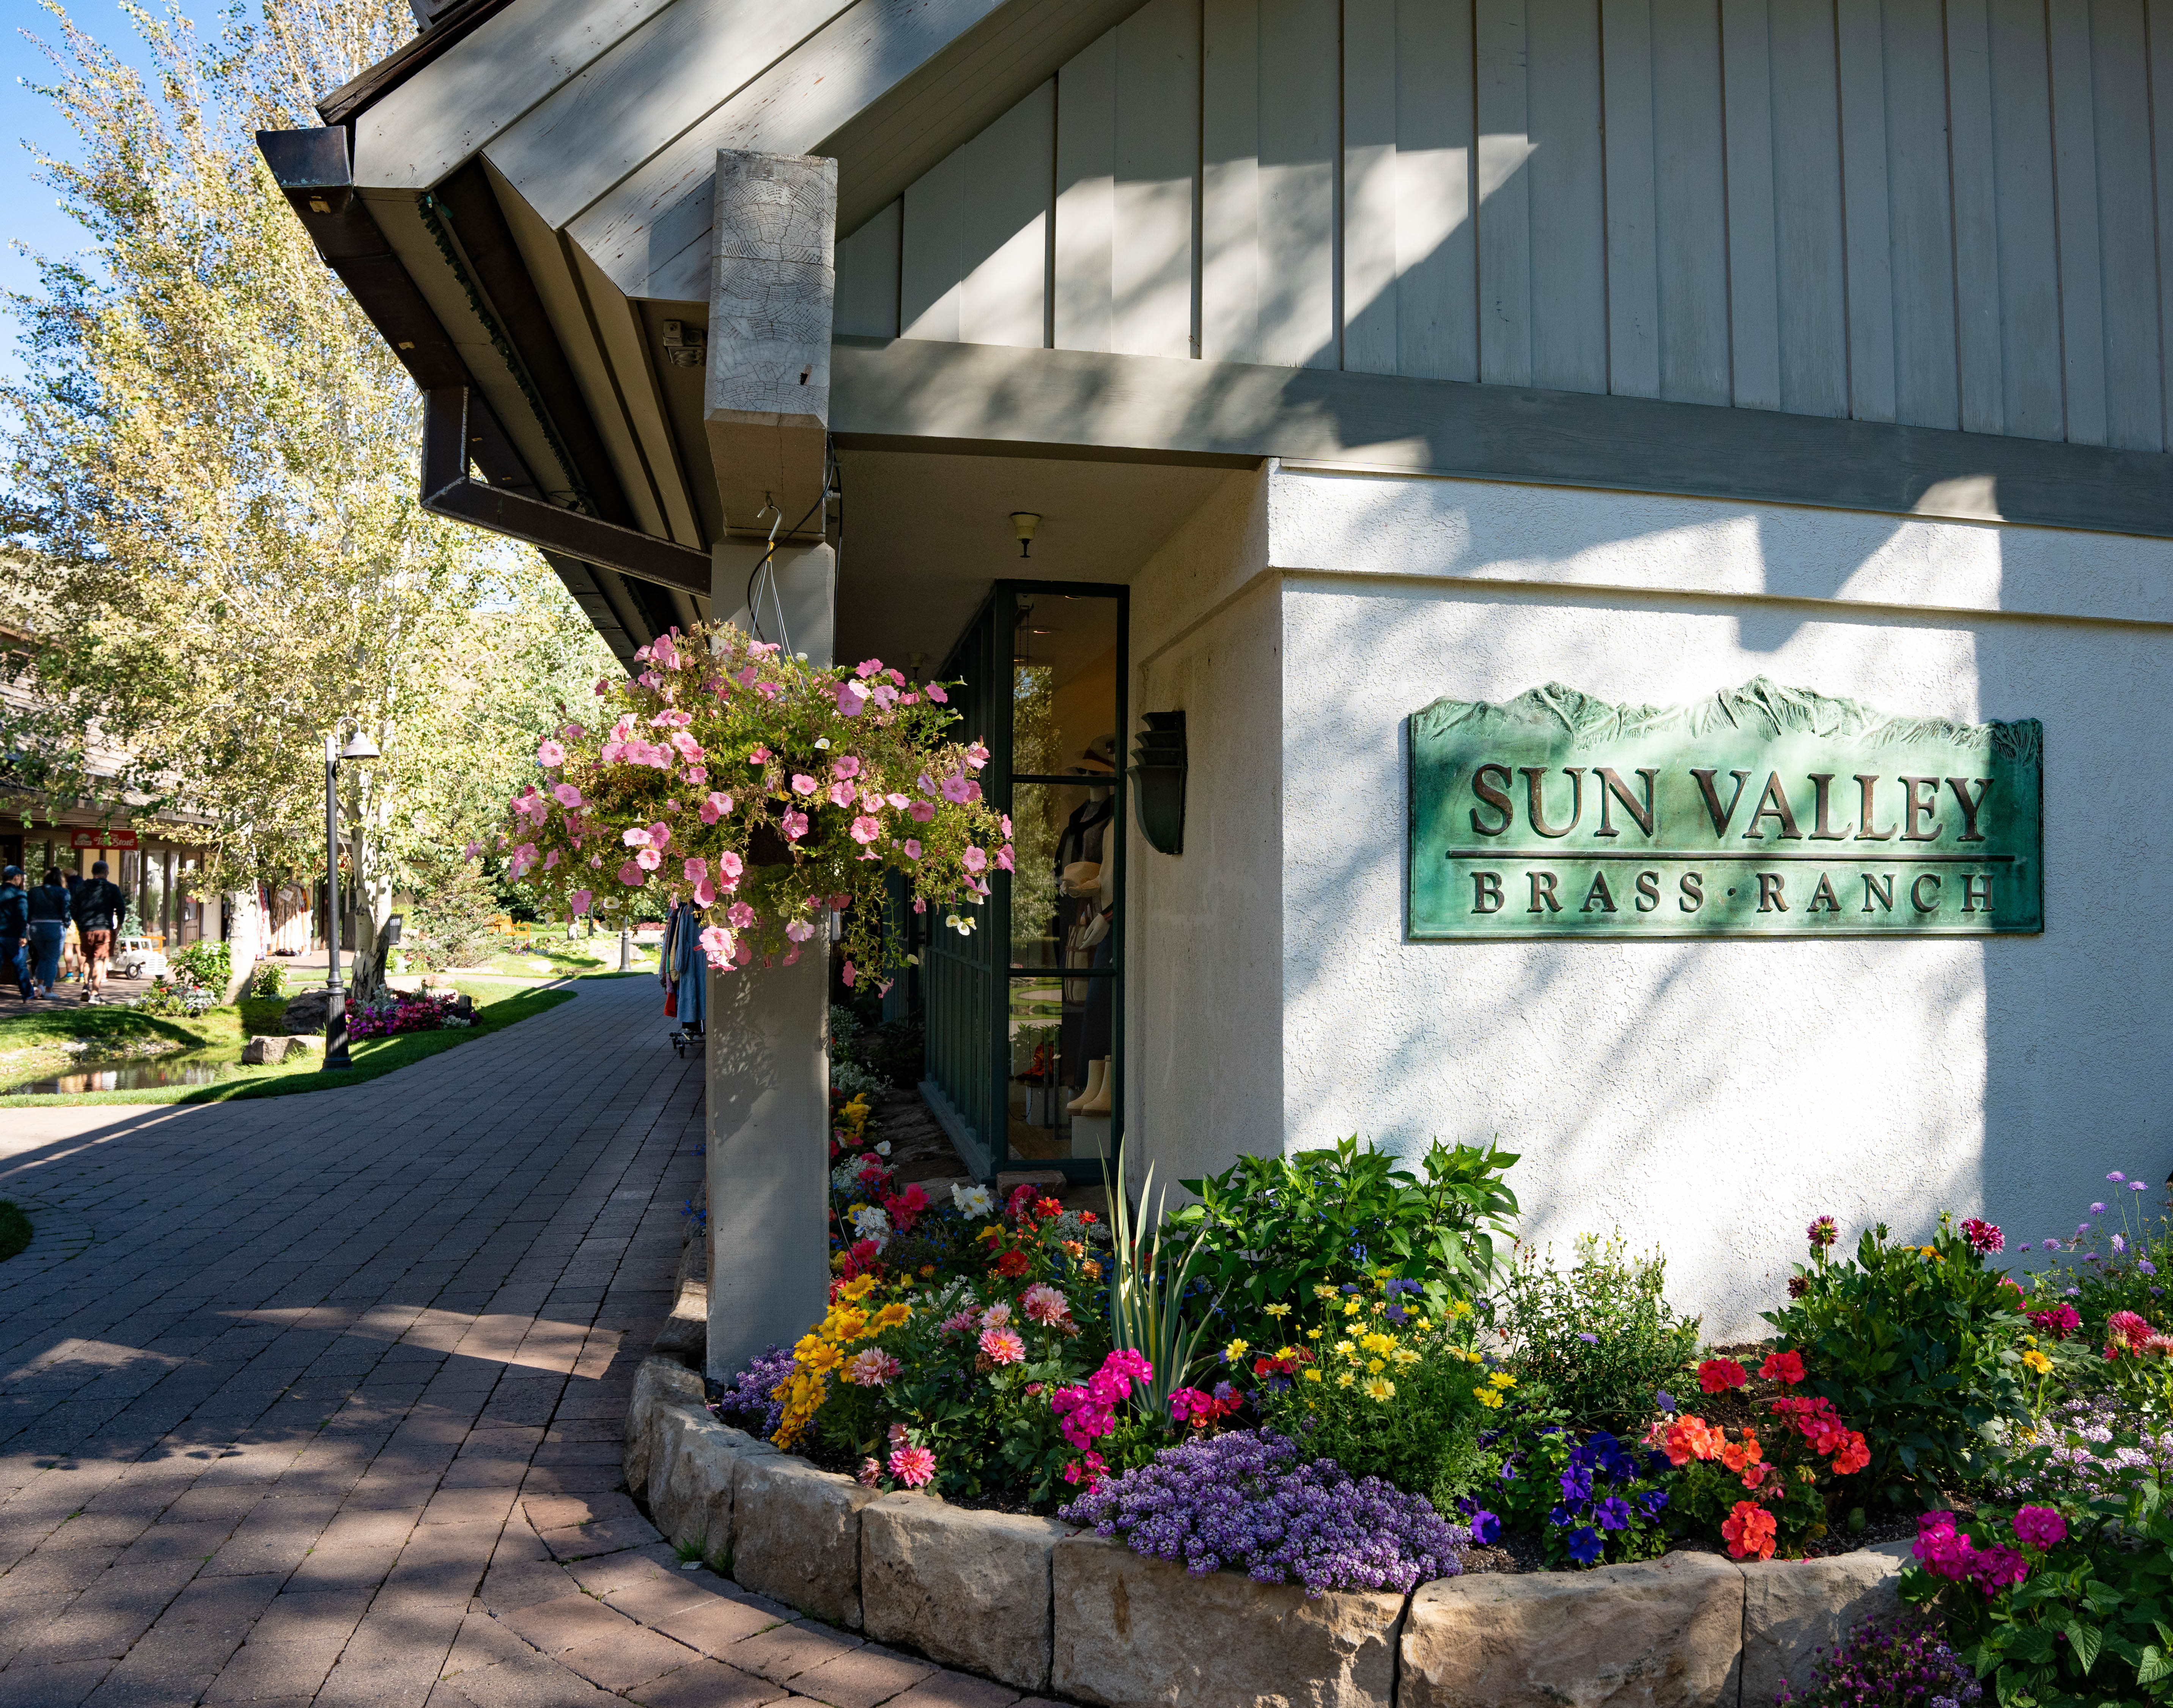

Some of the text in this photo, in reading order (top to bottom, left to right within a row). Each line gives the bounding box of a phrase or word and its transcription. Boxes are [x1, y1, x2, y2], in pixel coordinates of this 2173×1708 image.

[1469, 763, 1995, 842] SUN VALLEY
[112, 837, 134, 846] Store
[1469, 871, 1996, 914] BRASS RANCH
